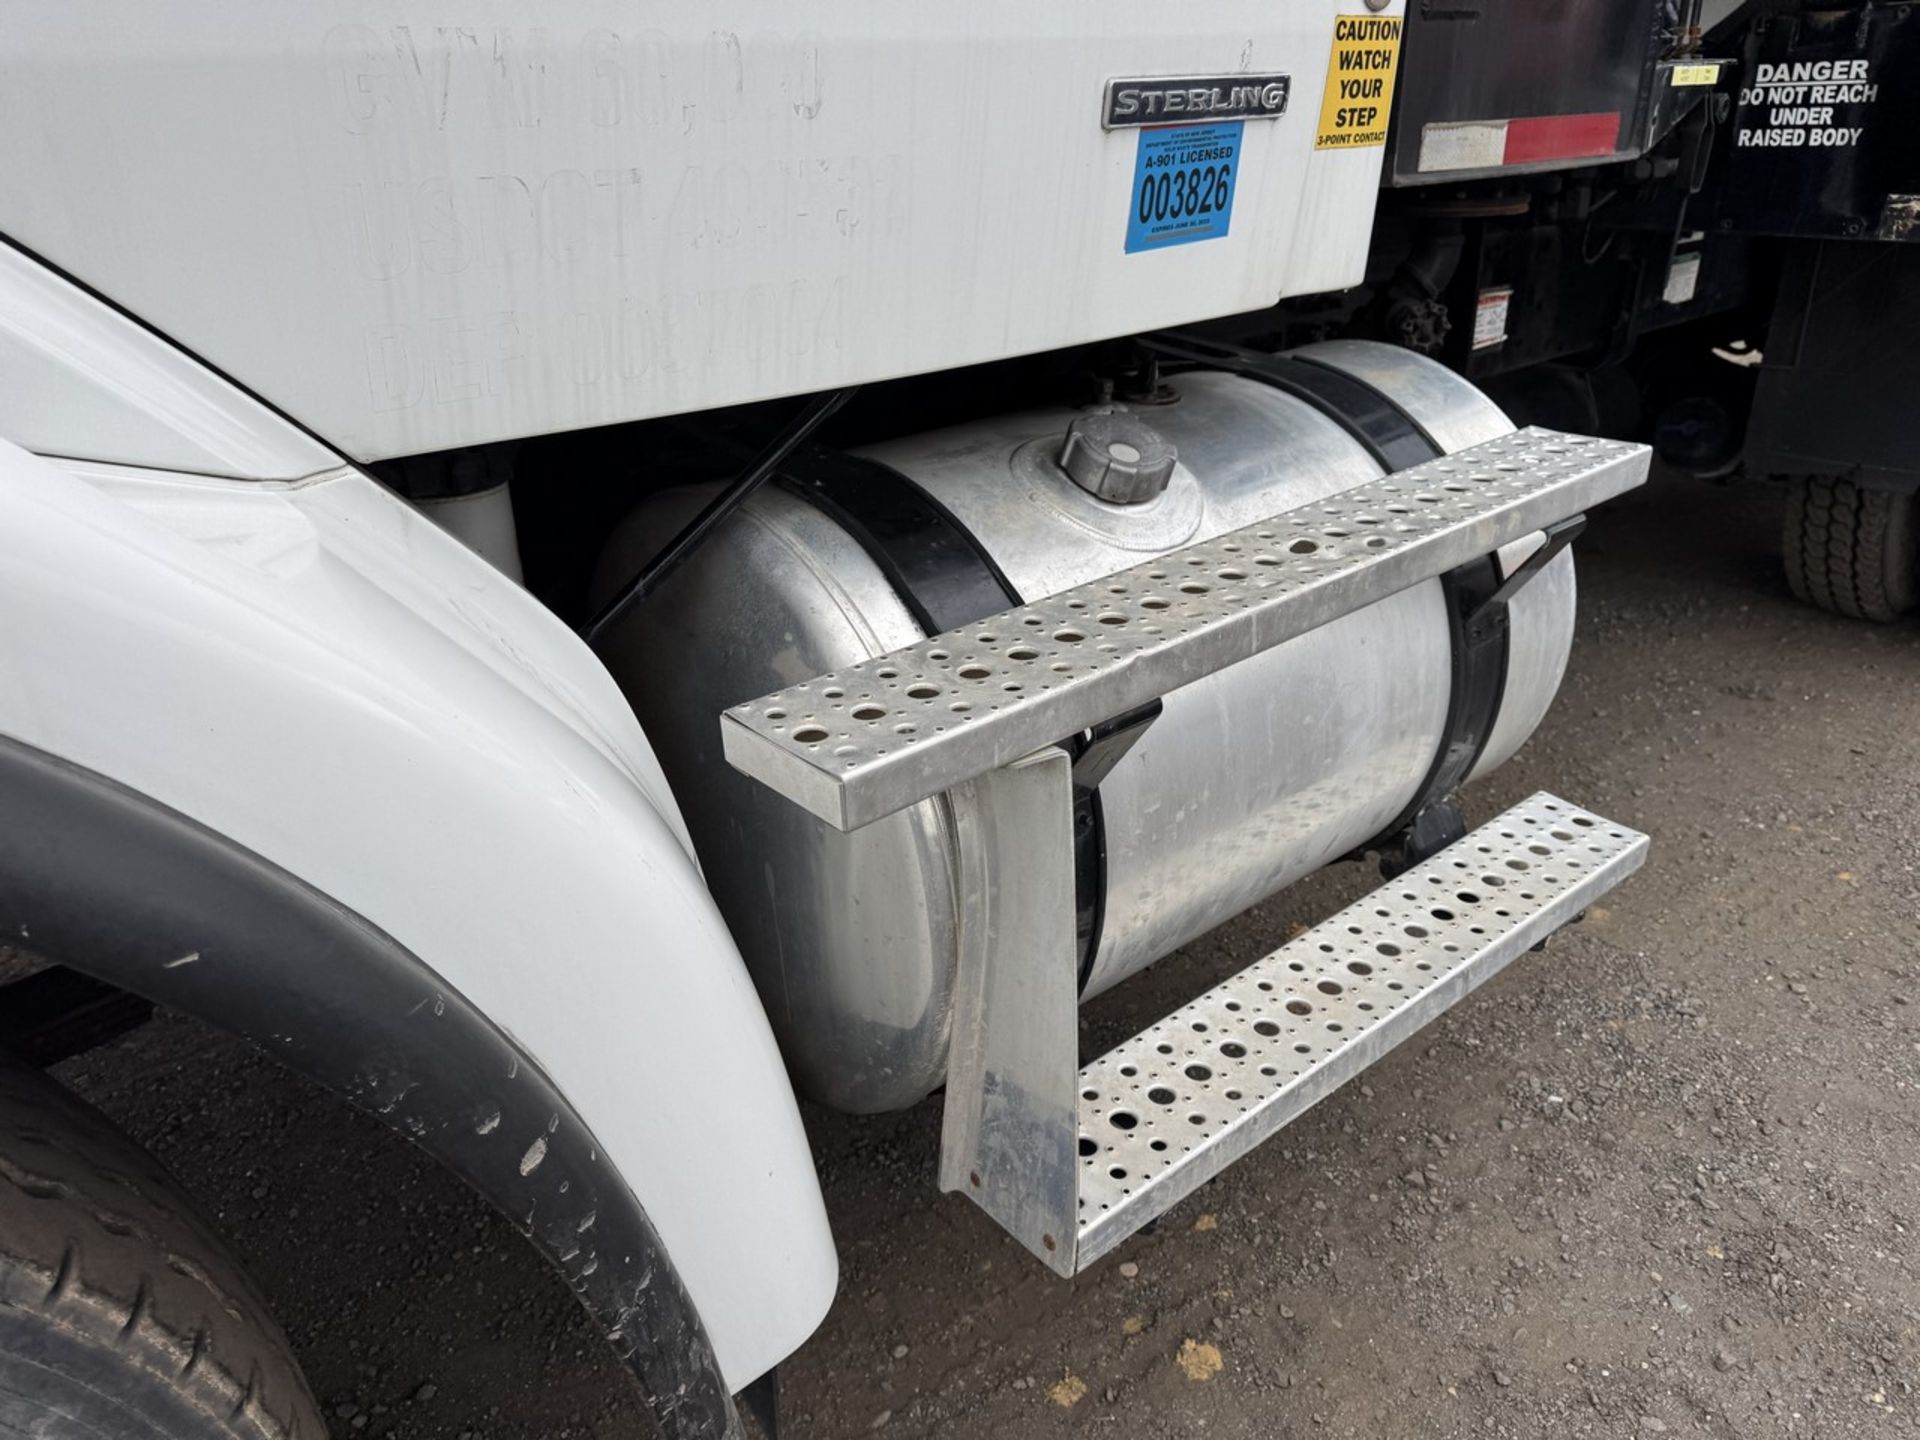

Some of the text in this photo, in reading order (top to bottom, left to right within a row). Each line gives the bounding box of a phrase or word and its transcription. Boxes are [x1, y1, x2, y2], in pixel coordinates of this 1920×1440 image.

[1335, 20, 1401, 41] CAUTION
[1339, 49, 1392, 71] WATCH
[1755, 59, 1870, 83] DANGER
[1114, 82, 1285, 117] STERLING
[1340, 78, 1384, 100] YOUR
[1738, 84, 1878, 106] DO NOT REACH
[1335, 106, 1378, 128] STEP
[1769, 106, 1834, 126] UNDER
[1317, 130, 1386, 146] 3-POINT CONTACT
[1737, 127, 1863, 147] RAISED BODY
[1145, 152, 1176, 169] A-901
[1179, 146, 1234, 165] LICENSED
[1139, 163, 1231, 224] 003826
